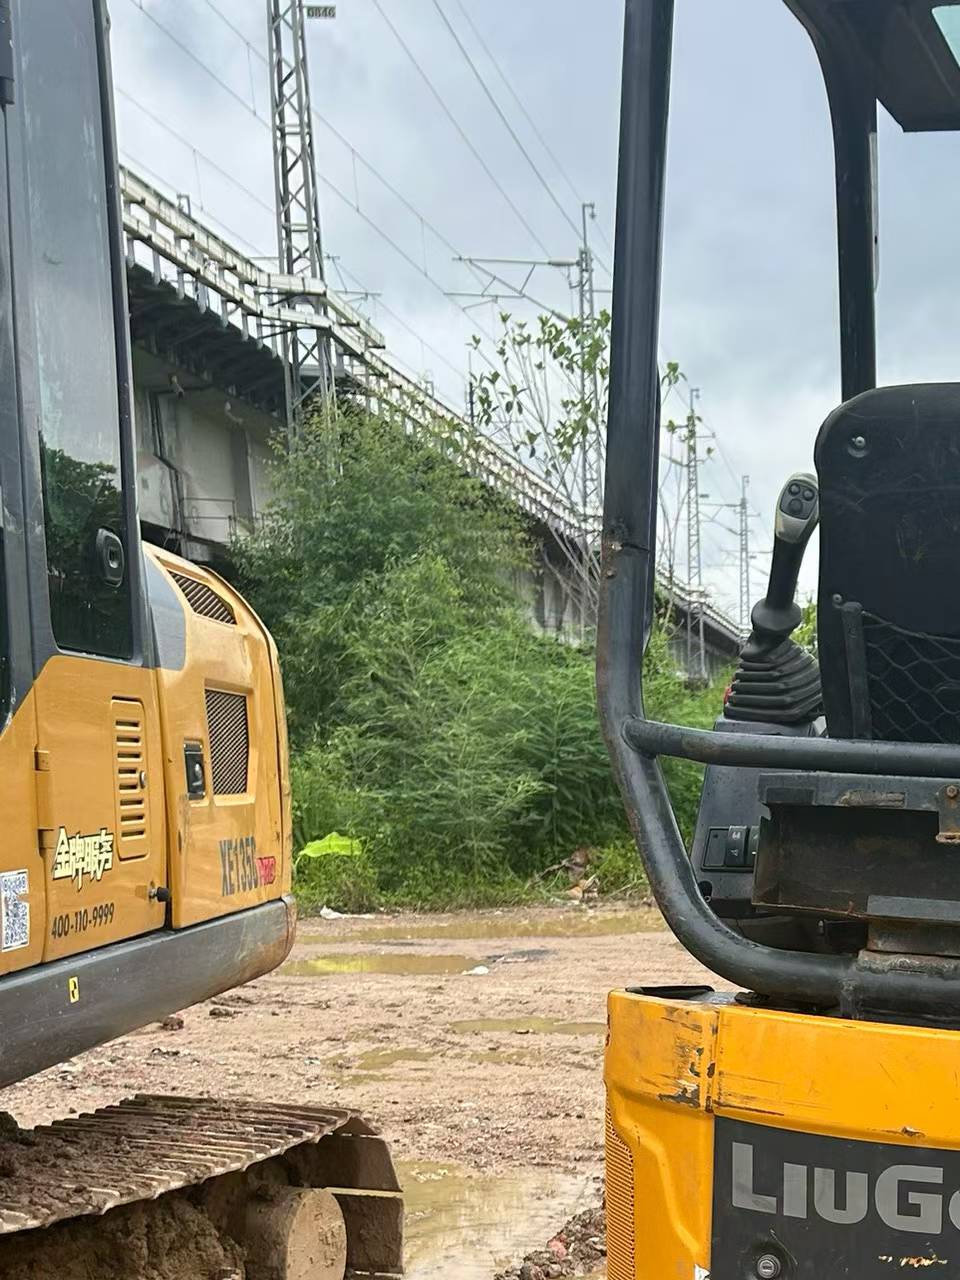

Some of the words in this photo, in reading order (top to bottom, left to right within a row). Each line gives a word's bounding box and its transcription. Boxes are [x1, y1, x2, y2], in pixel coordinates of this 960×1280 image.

[52, 826, 114, 892] 金牌服务
[51, 902, 115, 939] 400-110-9999
